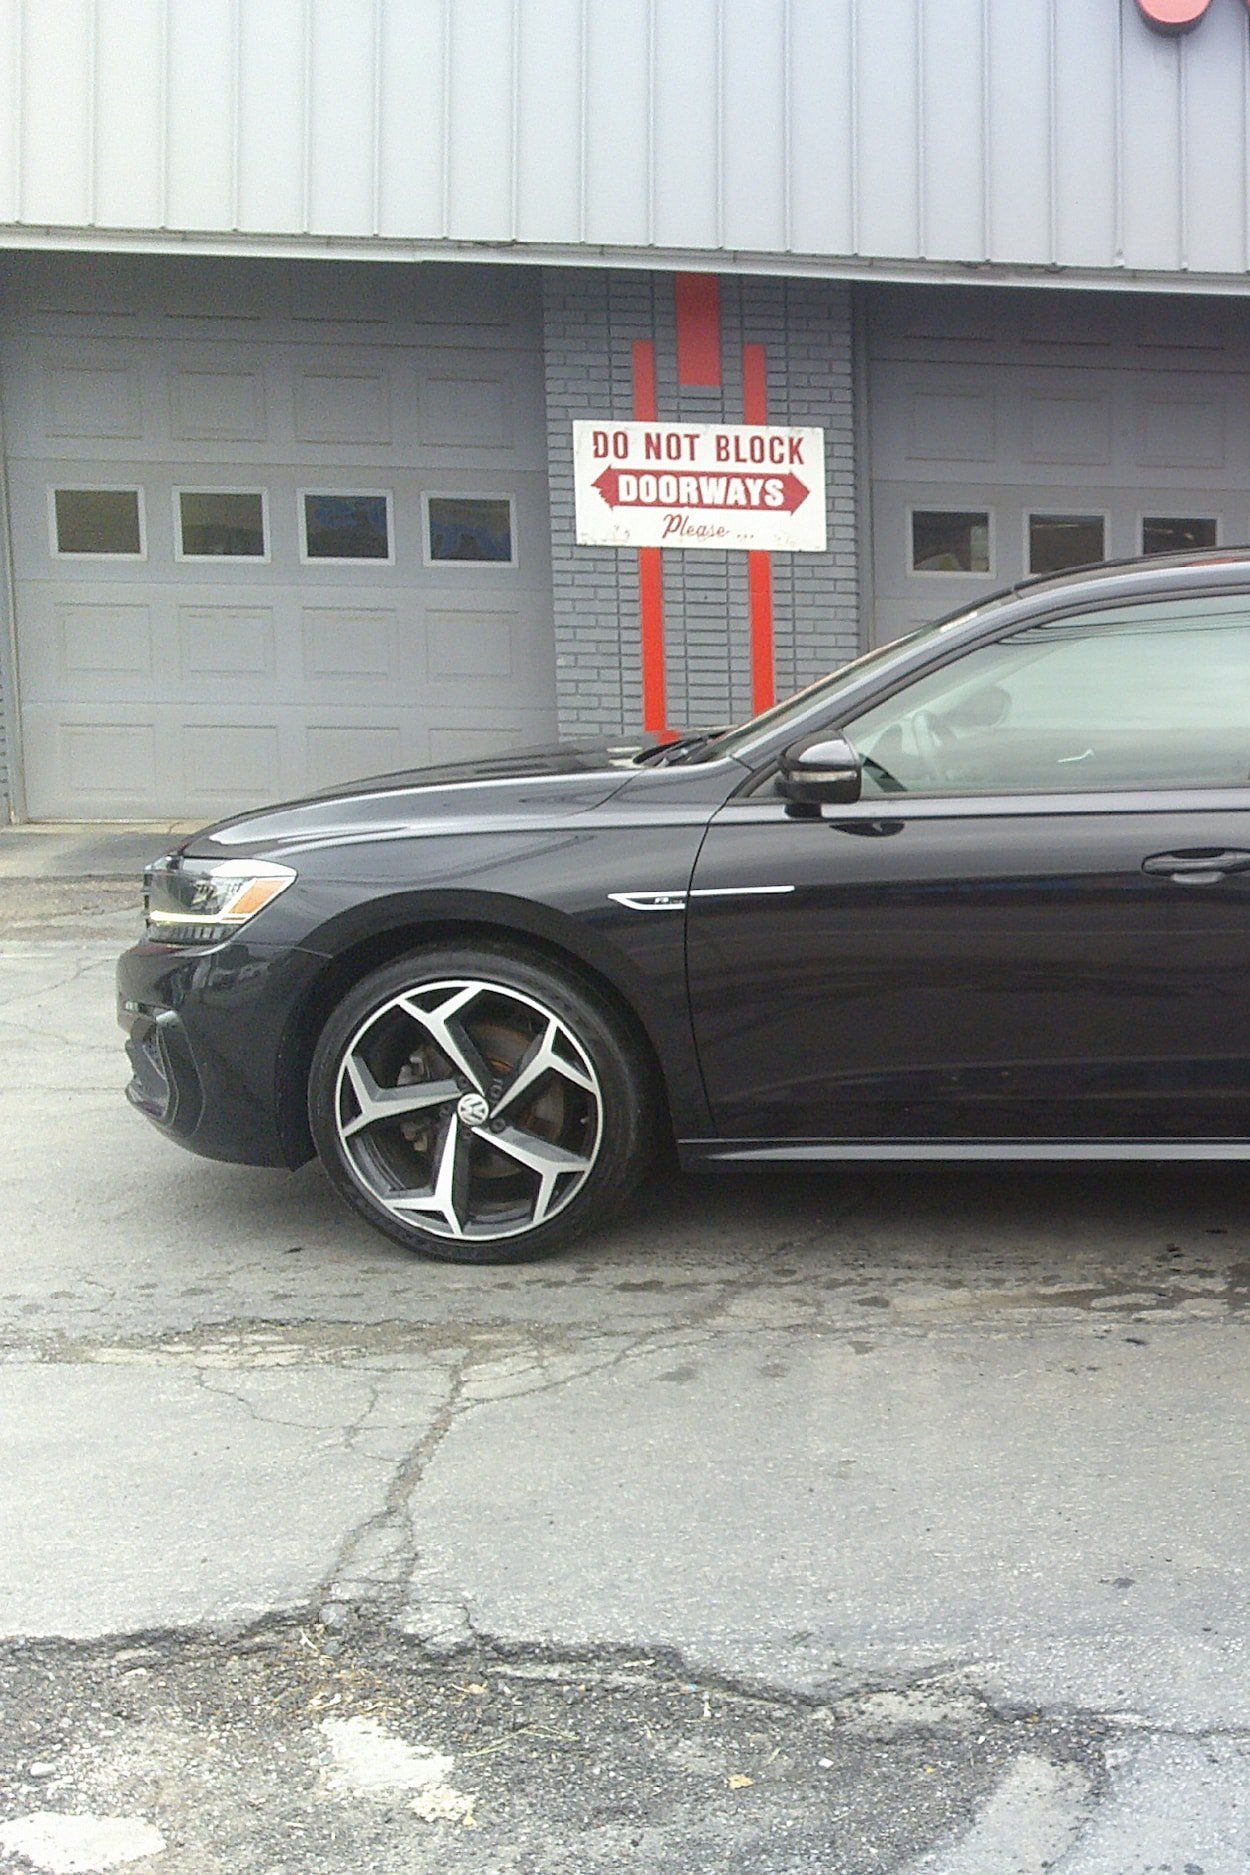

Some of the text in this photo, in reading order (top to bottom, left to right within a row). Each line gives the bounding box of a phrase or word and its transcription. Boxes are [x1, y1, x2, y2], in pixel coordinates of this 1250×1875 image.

[592, 430, 805, 465] DO NOT BLOCK
[617, 473, 785, 507] DOORWAYS
